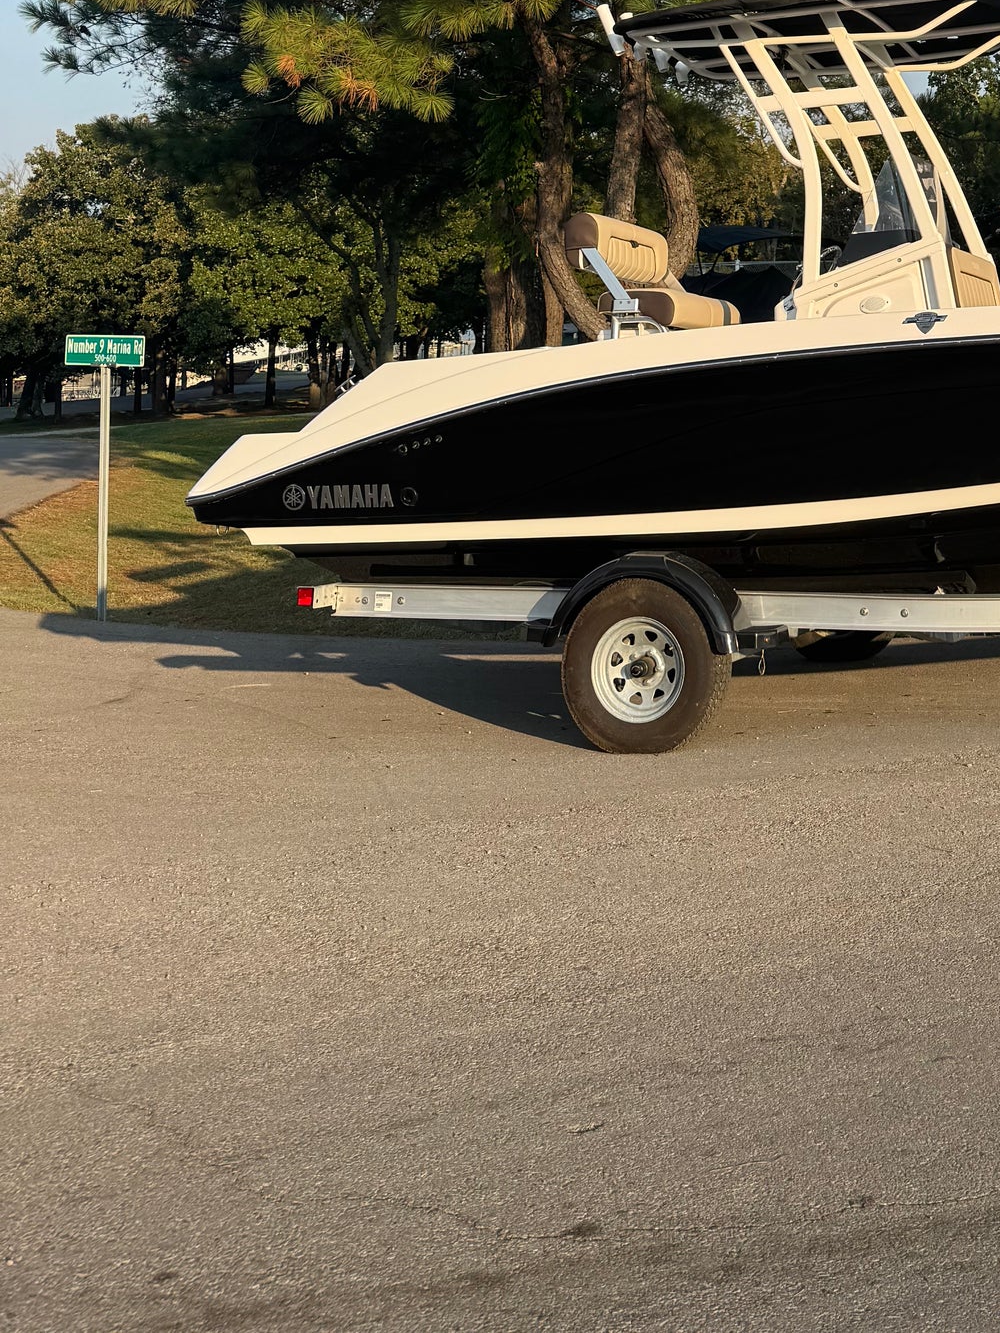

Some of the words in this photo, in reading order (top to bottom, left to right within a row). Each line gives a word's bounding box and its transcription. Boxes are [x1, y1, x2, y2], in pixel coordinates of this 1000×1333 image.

[67, 338, 97, 354] Number
[99, 339, 105, 354] 9
[107, 339, 131, 354] Marina
[133, 340, 142, 354] Rd
[95, 354, 116, 363] 500-600
[306, 483, 395, 509] YAMAHA
